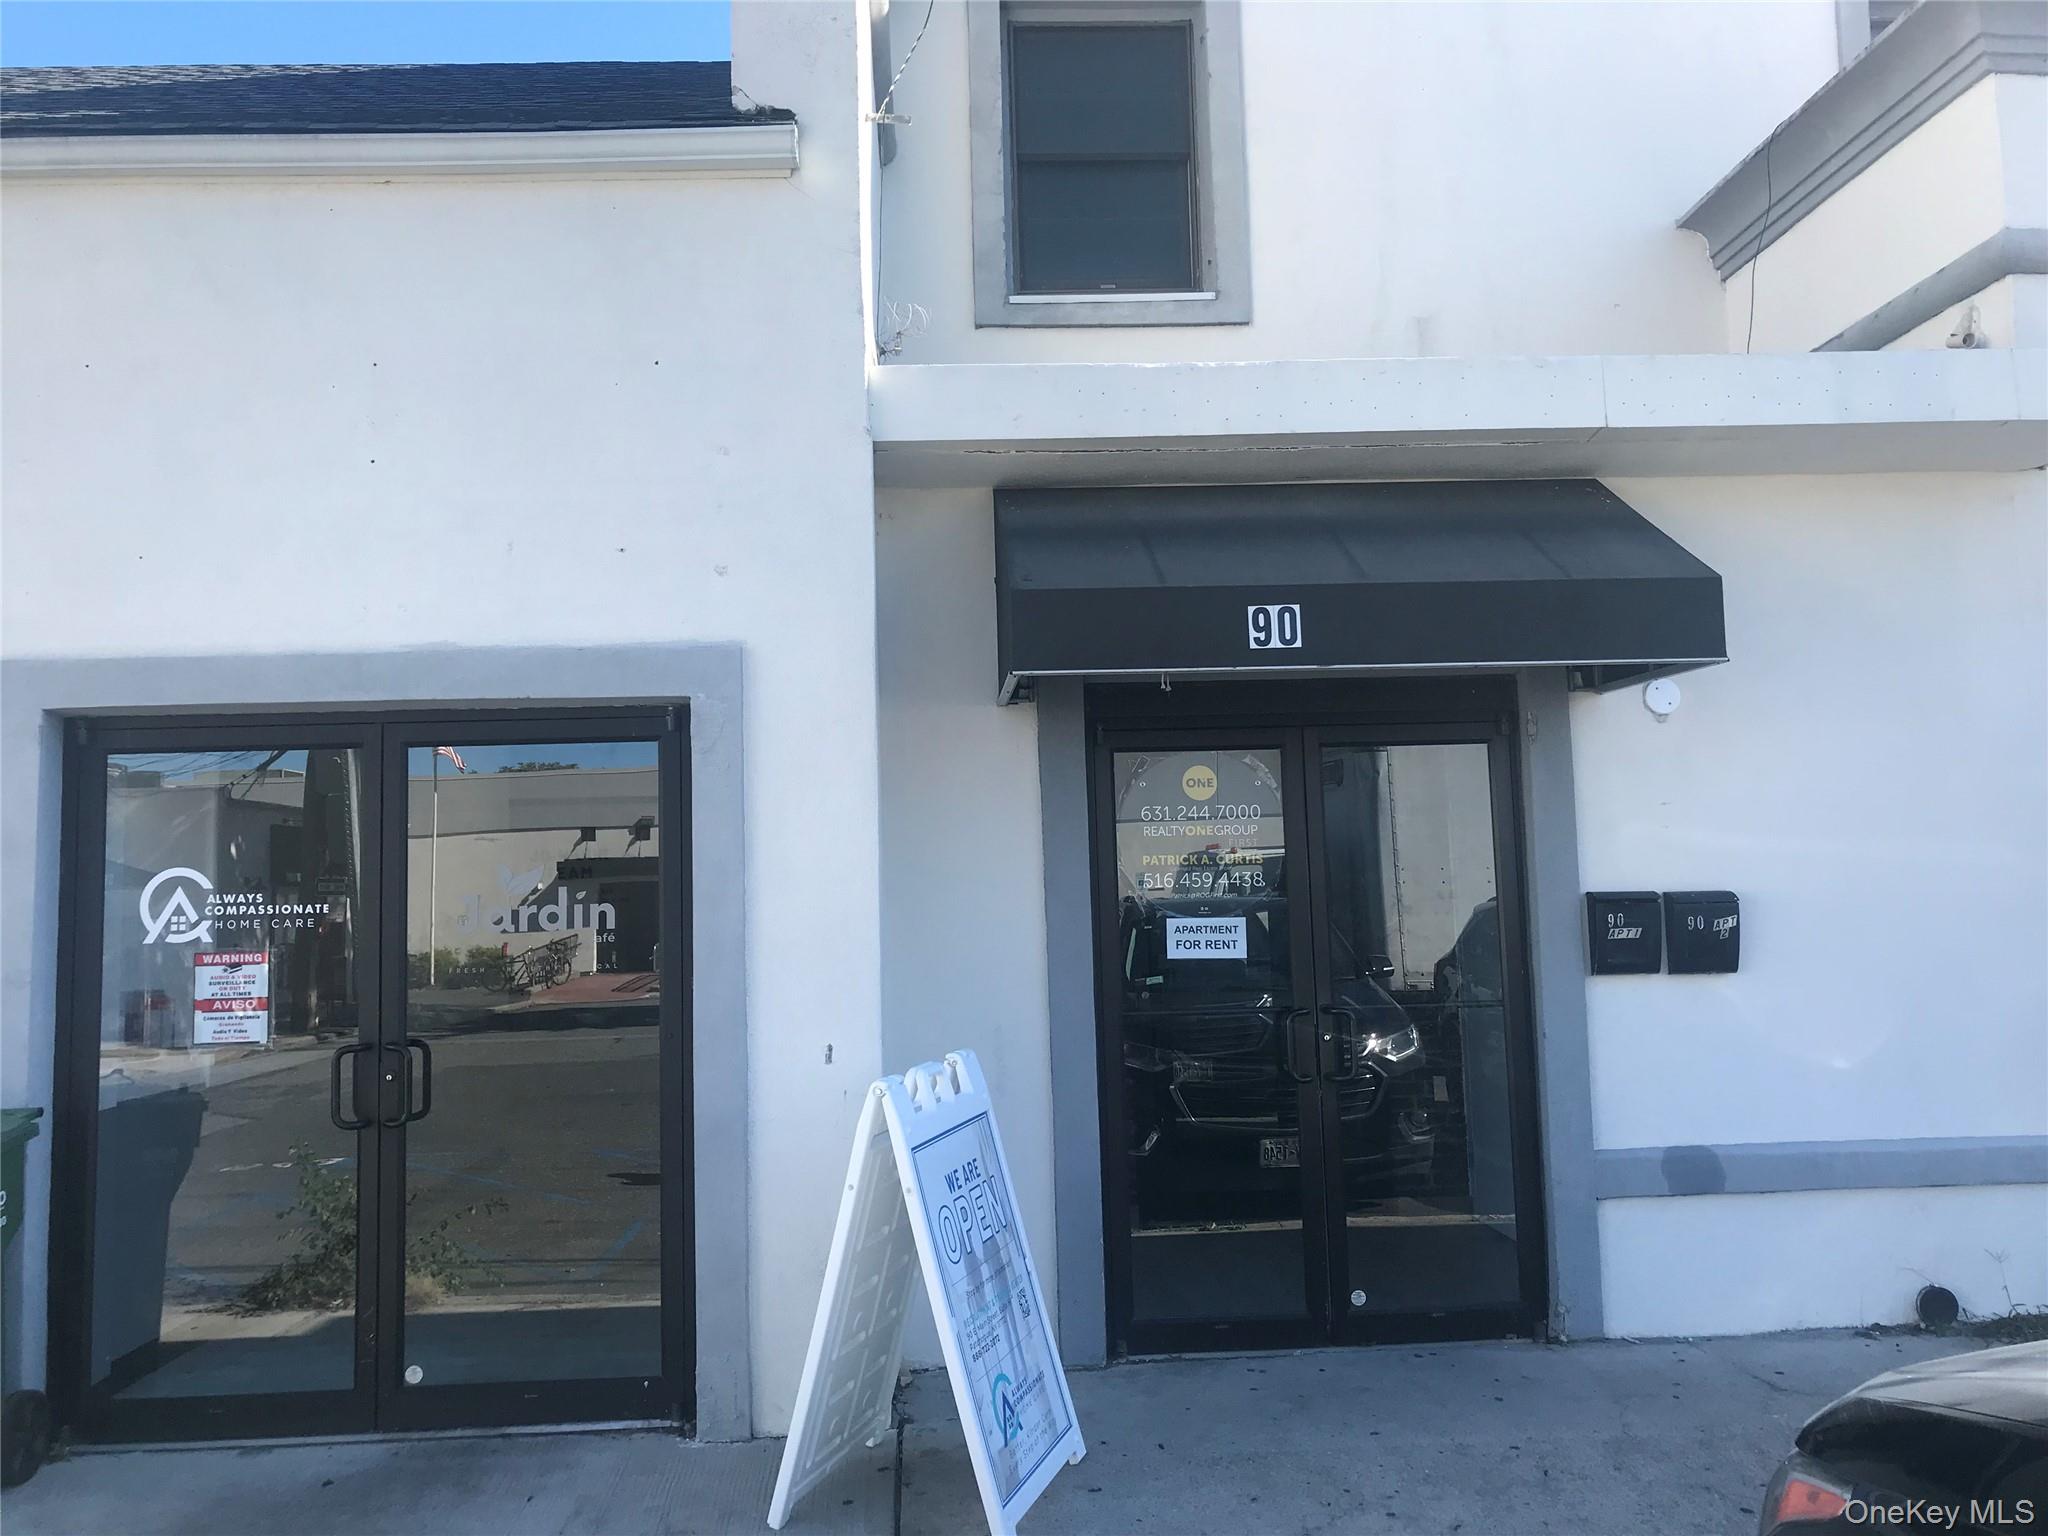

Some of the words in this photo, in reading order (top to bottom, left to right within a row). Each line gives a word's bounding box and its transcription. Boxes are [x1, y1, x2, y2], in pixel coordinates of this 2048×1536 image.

[1252, 606, 1298, 647] 90
[1185, 778, 1215, 788] ONE
[1140, 805, 1261, 821] 631.244.7000
[1142, 855, 1198, 866] PATRICK
[1200, 854, 1213, 865] A.
[1216, 854, 1264, 865] CURTIS
[1143, 872, 1265, 888] 516.459.4438
[206, 893, 264, 904] ALWAYS
[204, 903, 329, 915] COMPASSIONATE
[214, 919, 261, 929] HOME
[271, 918, 315, 928] CARE
[1608, 912, 1624, 928] 90
[1688, 915, 1704, 930] 90
[1713, 915, 1737, 931] APT
[1174, 925, 1239, 934] APARTMENT
[1720, 928, 1729, 940] 2
[1175, 940, 1201, 950] FOR
[1205, 940, 1238, 950] RENT
[202, 953, 262, 964] WARNING
[213, 1000, 256, 1010] AVISO
[944, 1168, 963, 1194] WE
[961, 1158, 981, 1186] ARE
[938, 1174, 1008, 1265] OPEN
[1011, 1377, 1027, 1397] ALWAYS
[1013, 1370, 1045, 1407] COMPASSIONATE
